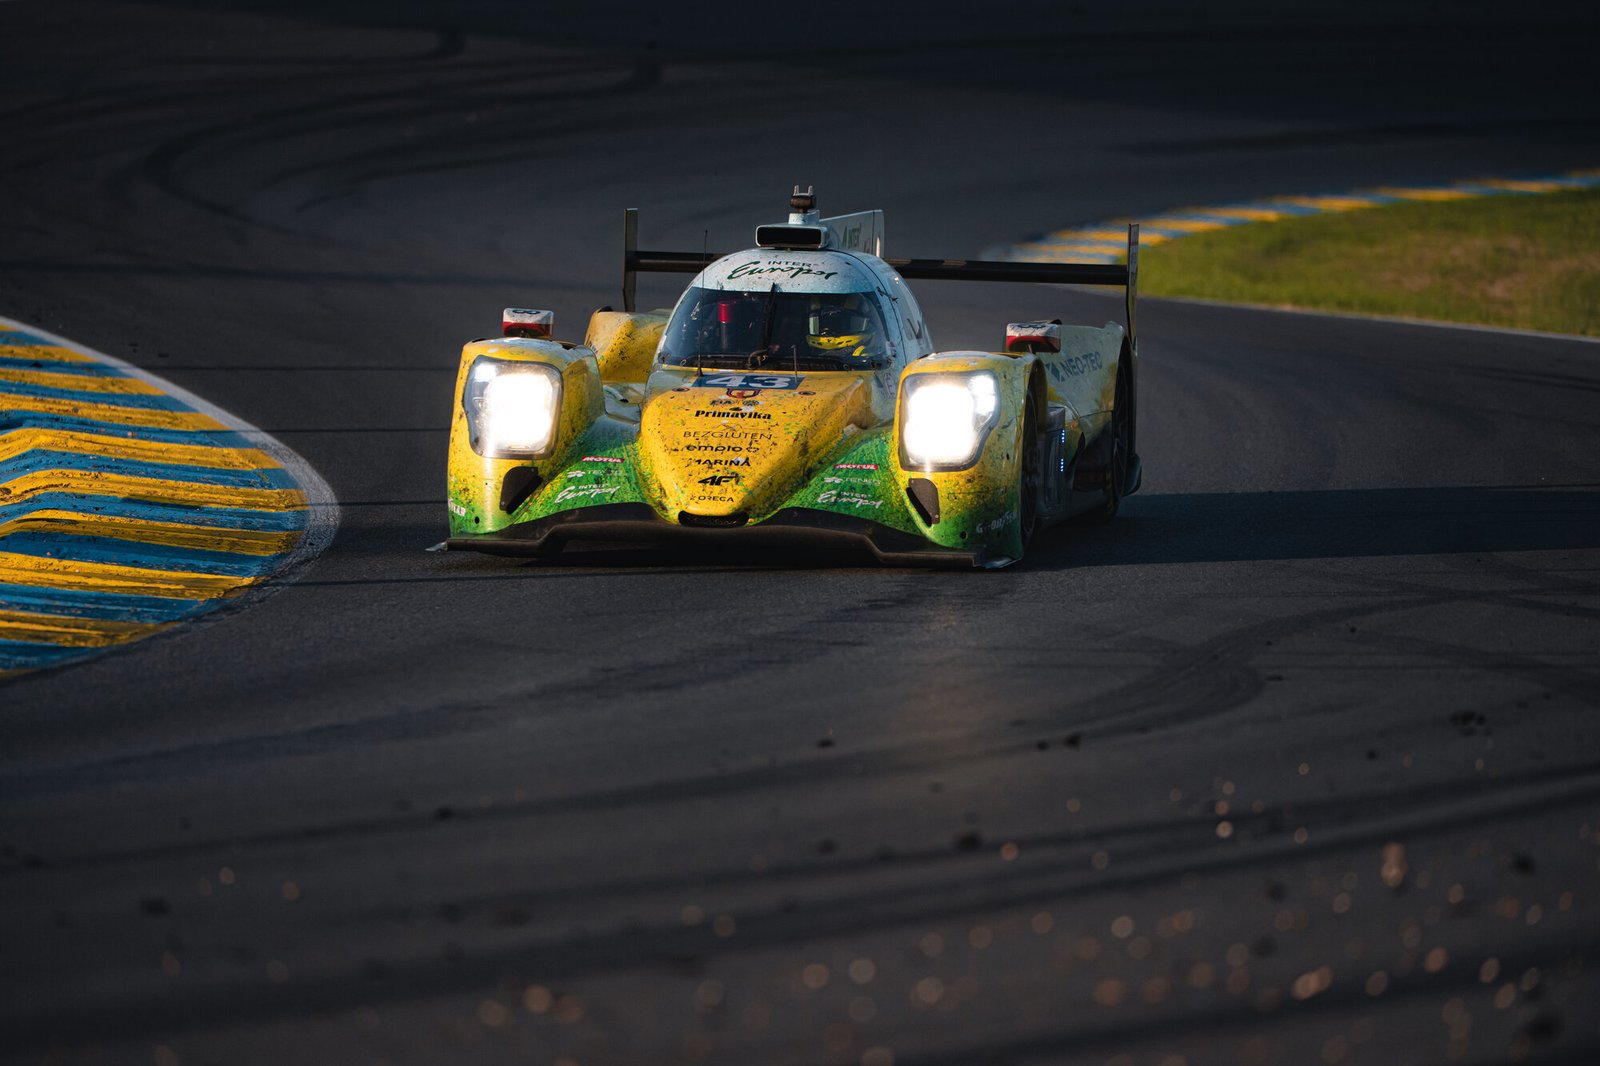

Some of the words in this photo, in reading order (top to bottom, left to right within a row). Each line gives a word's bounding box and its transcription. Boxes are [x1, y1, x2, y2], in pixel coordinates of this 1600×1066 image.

[705, 375, 791, 388] 43
[694, 410, 772, 420] Primavika
[683, 431, 773, 440] BEZGLUTEN
